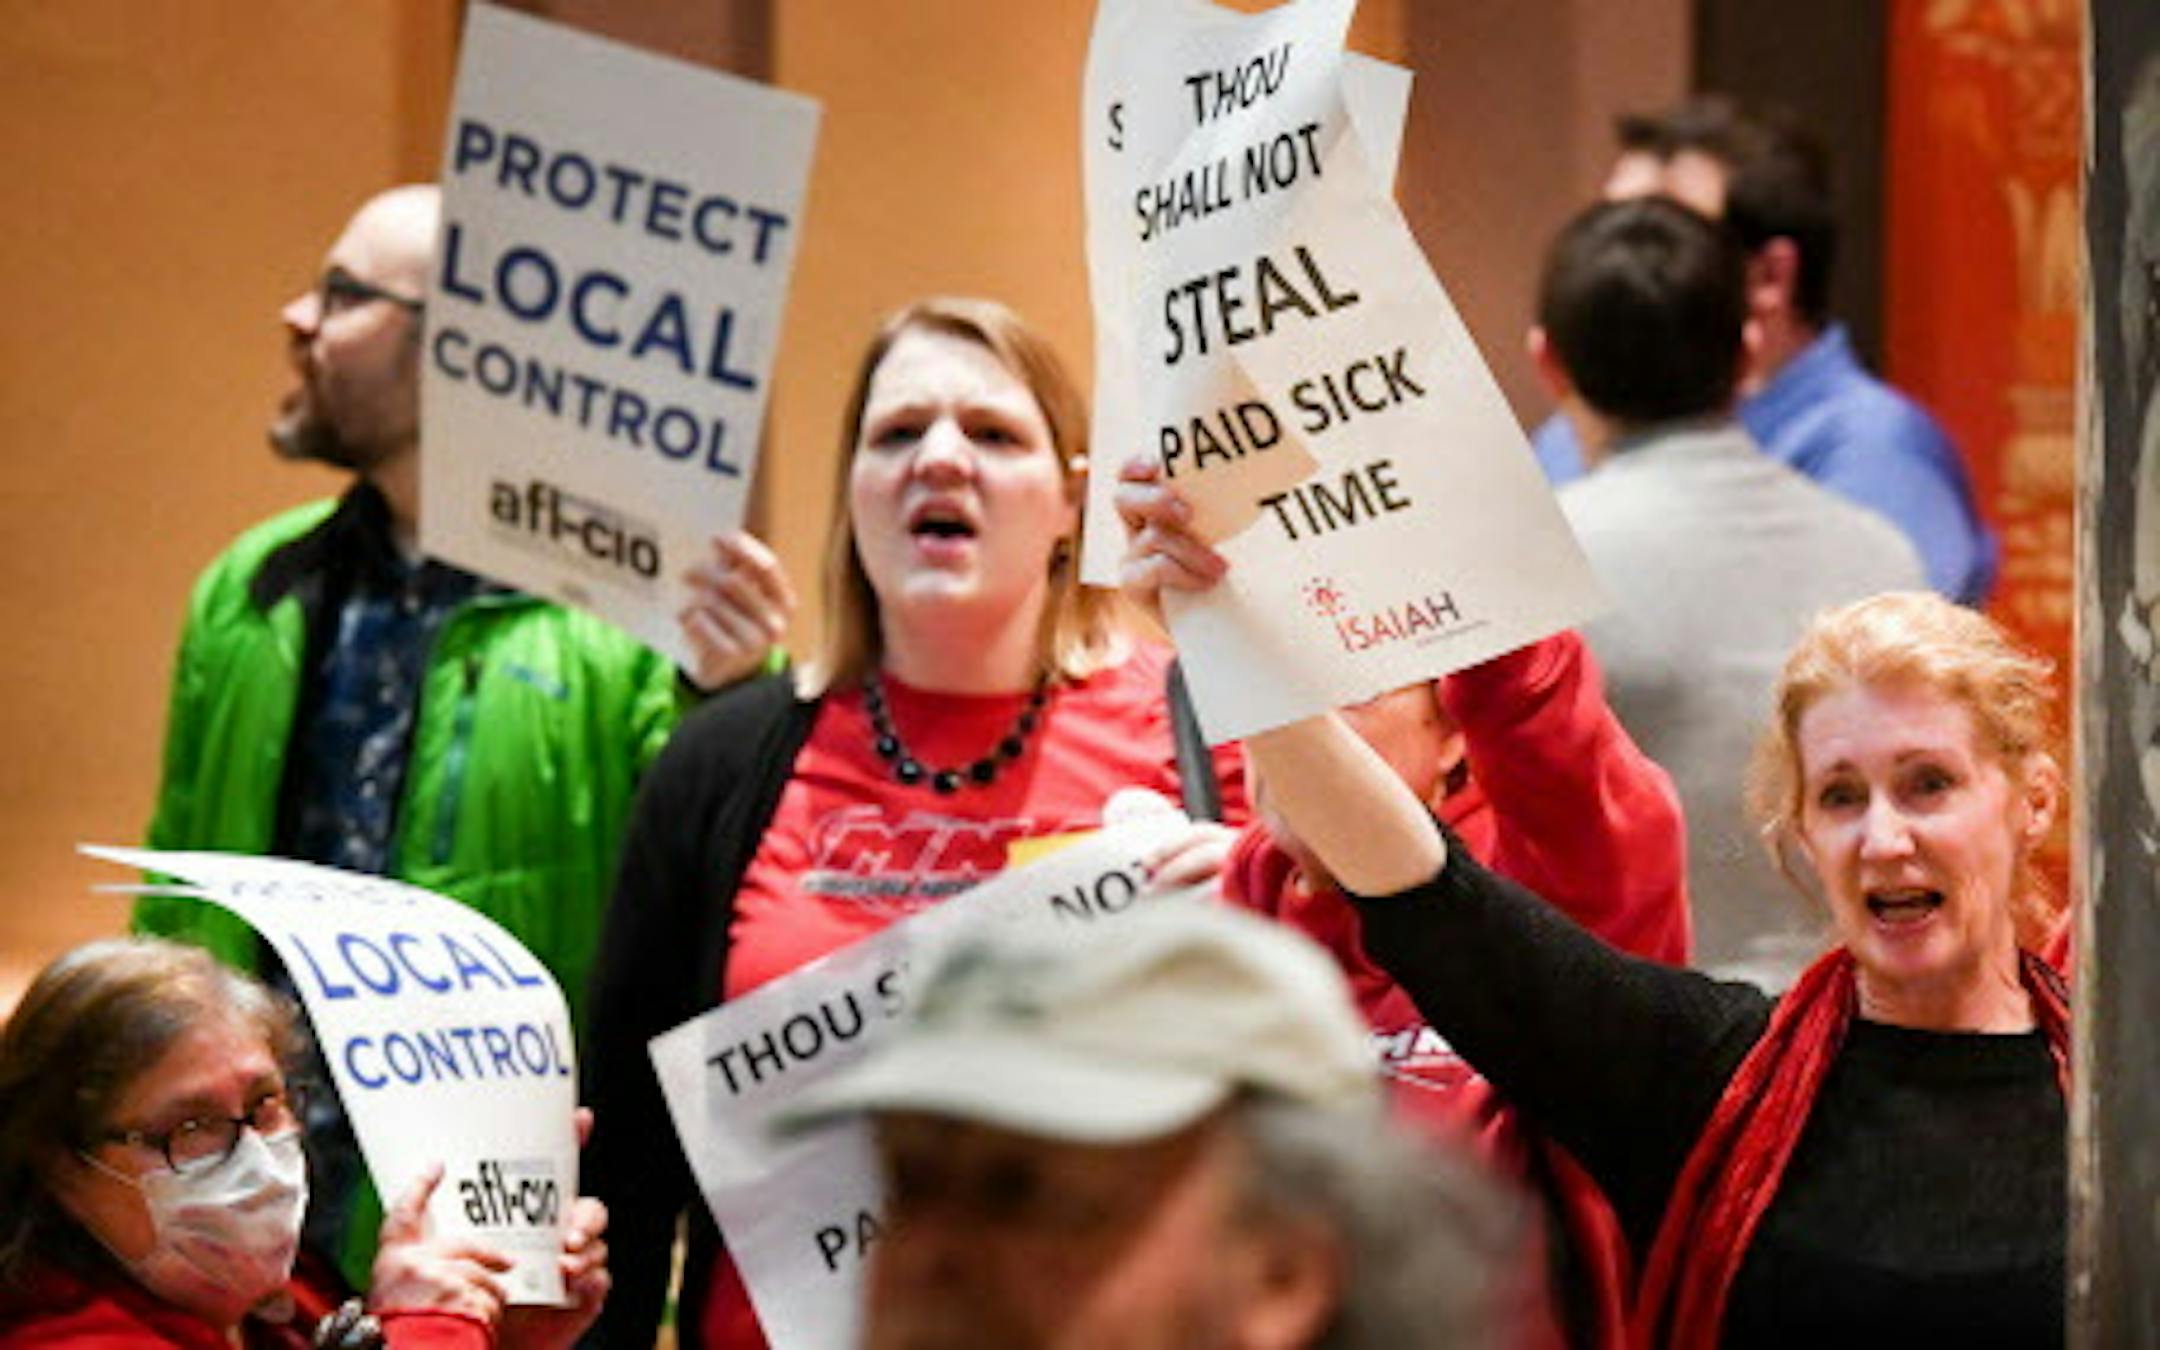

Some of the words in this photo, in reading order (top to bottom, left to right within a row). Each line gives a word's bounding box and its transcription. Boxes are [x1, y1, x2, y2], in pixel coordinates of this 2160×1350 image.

[1185, 41, 1292, 128] THOU
[454, 119, 788, 263] PROTECT
[1134, 151, 1232, 242] SHALL
[1243, 122, 1325, 198] NOT
[440, 223, 758, 392] LOCAL
[1163, 244, 1359, 366] STEAL
[433, 328, 740, 476] CONTROL
[1159, 397, 1282, 478] PAID
[1290, 347, 1425, 436] SICK
[1260, 459, 1412, 541] TIME
[1335, 591, 1461, 653] ISAIAH
[1050, 862, 1154, 921] NO
[291, 933, 542, 999] LOCAL
[345, 1023, 569, 1089] CONTROL
[708, 993, 863, 1095] THOU
